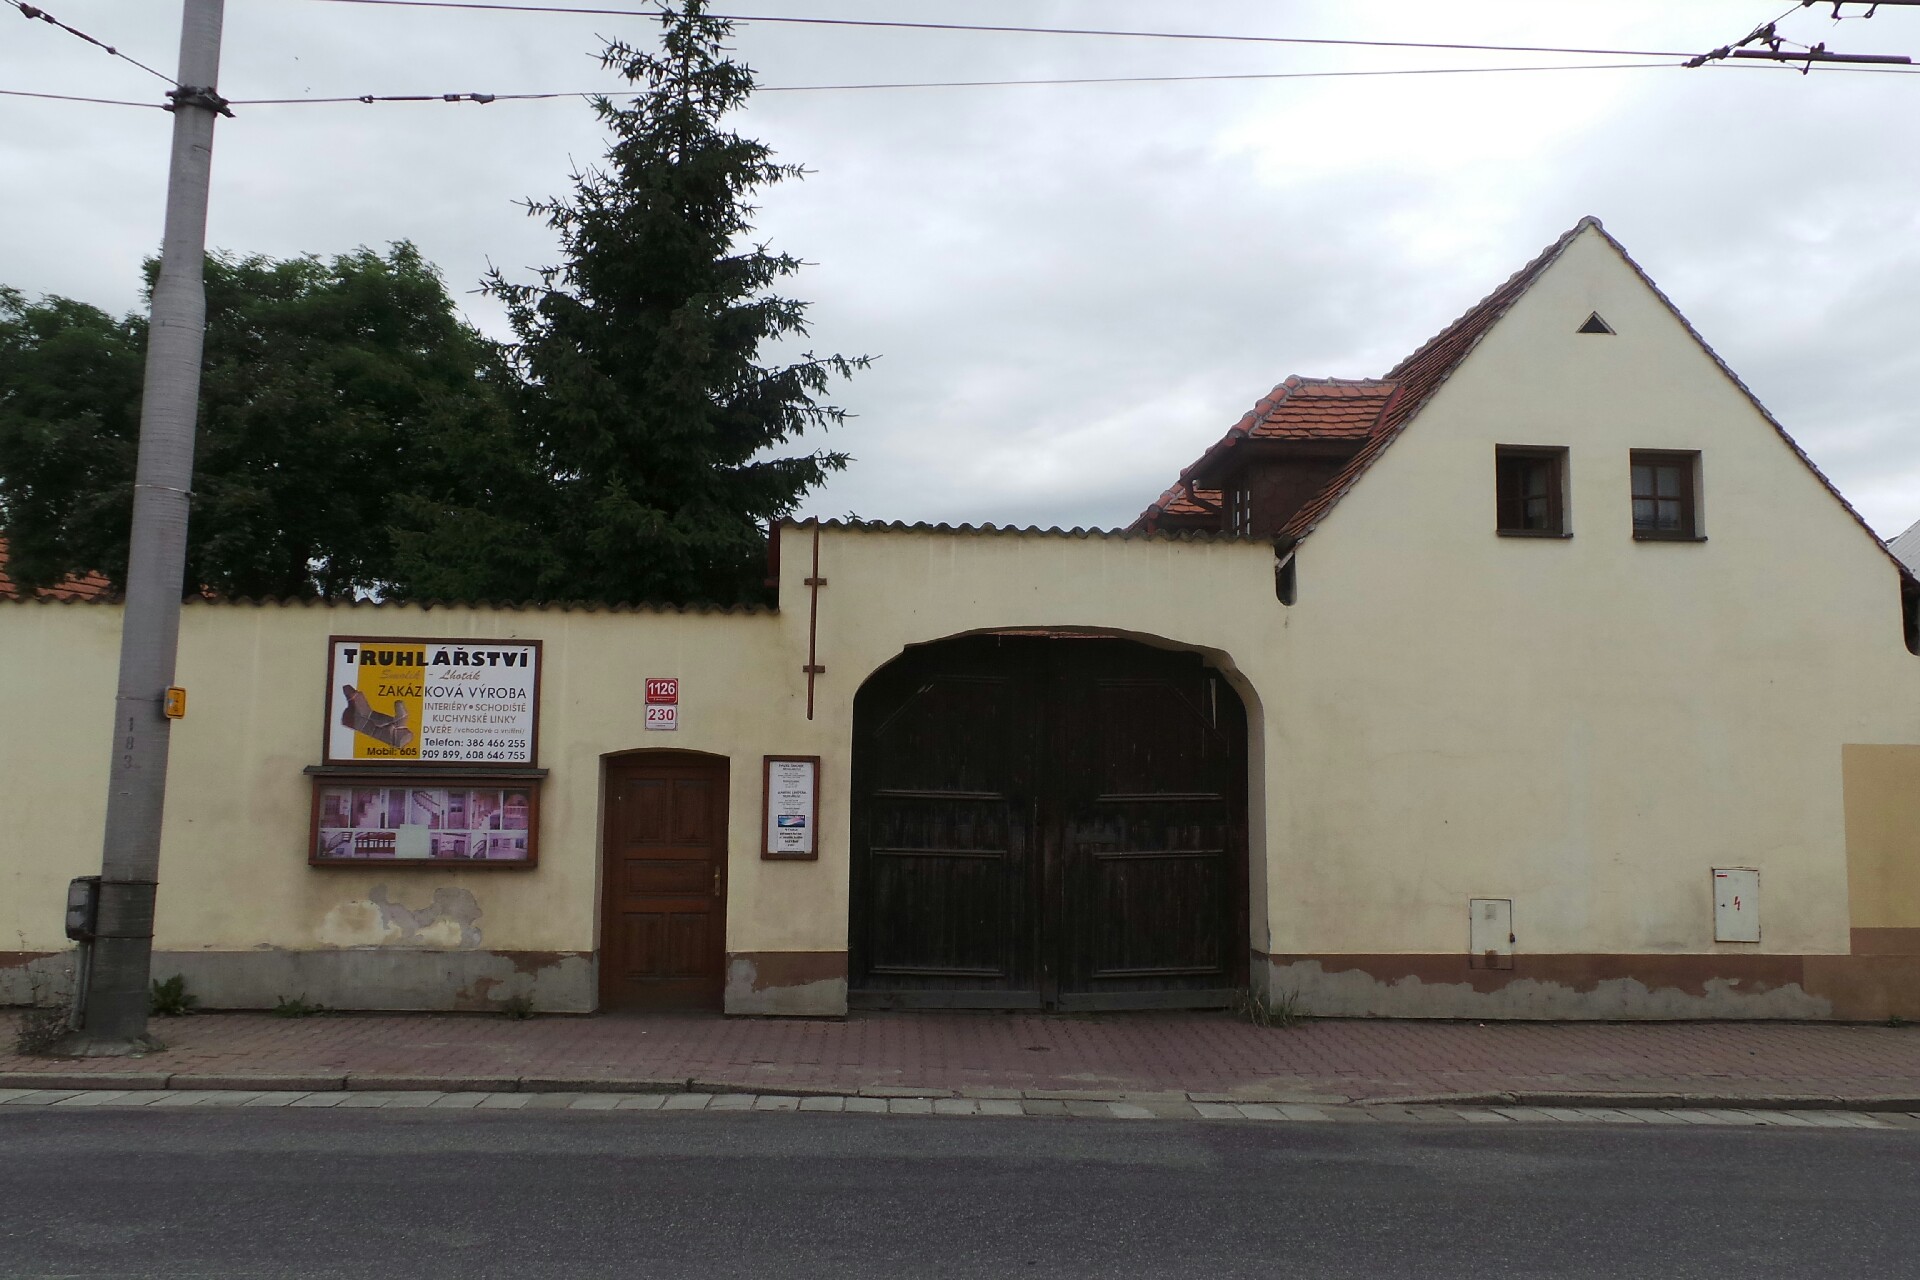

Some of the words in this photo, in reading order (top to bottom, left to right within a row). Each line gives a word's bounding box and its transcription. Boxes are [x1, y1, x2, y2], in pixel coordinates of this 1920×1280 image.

[344, 647, 528, 667] TRUHLÁŘSTVÍ
[439, 669, 481, 681] Lhoták
[378, 683, 464, 698] ZAKÁZKOVÁ
[468, 683, 527, 699] VÝROBA
[648, 682, 676, 695] 1126
[424, 701, 468, 711] INTERIÉRY
[432, 713, 488, 724] KUCHYNSKÉ
[490, 715, 517, 724] LINKY
[648, 708, 674, 721] 230
[423, 724, 452, 734] DVEŘE
[425, 737, 464, 748] Telefon:
[466, 738, 485, 748] 386
[487, 738, 505, 749] 466
[507, 739, 526, 749] 255
[367, 747, 397, 756] Mobil:
[400, 747, 417, 756] 605
[422, 749, 440, 759] 909
[442, 750, 463, 760] 899,
[465, 750, 484, 760] 608
[486, 751, 505, 761] 646
[507, 751, 526, 761] 755
